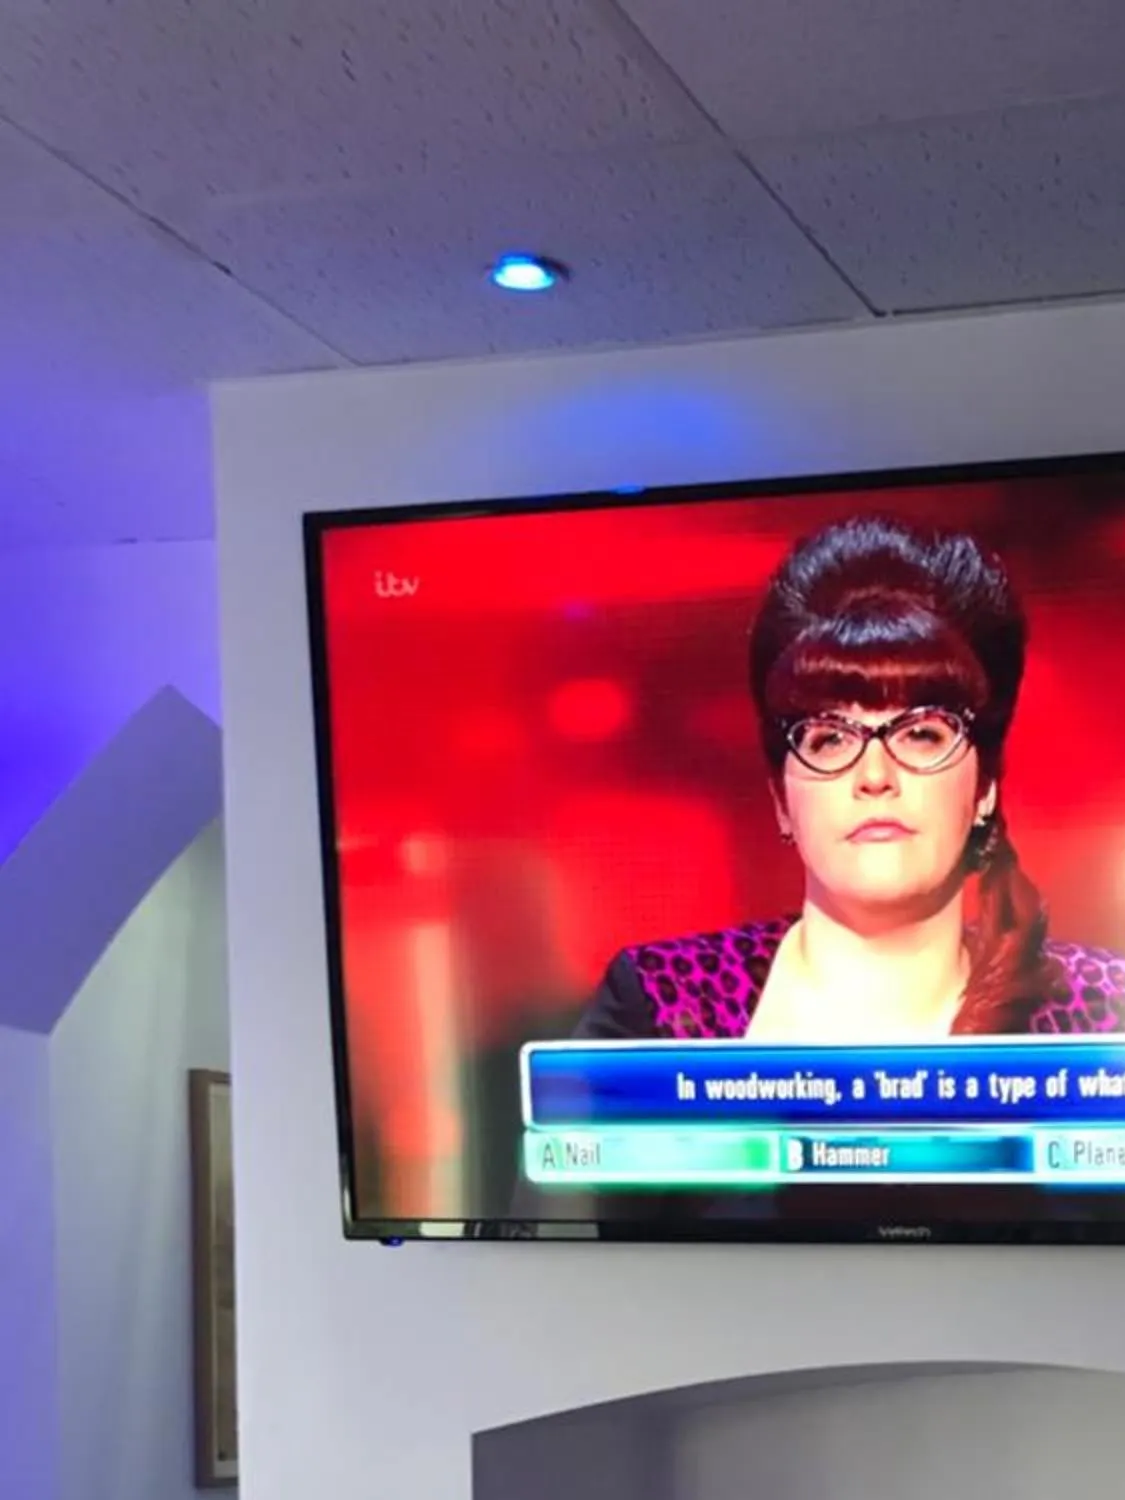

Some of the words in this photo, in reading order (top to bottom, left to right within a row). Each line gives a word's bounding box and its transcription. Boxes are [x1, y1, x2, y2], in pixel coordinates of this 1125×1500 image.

[374, 570, 420, 598] itv
[676, 1071, 696, 1100] In
[704, 1071, 842, 1106] woodworking,
[852, 1077, 866, 1099] a
[937, 1069, 957, 1099] is
[965, 1076, 979, 1099] a
[987, 1072, 1036, 1105] type
[1045, 1068, 1068, 1098] of
[542, 1142, 557, 1170] A
[565, 1141, 601, 1168] Nail
[787, 1138, 804, 1171] B
[812, 1140, 889, 1167] Hammer
[1047, 1140, 1061, 1169] C
